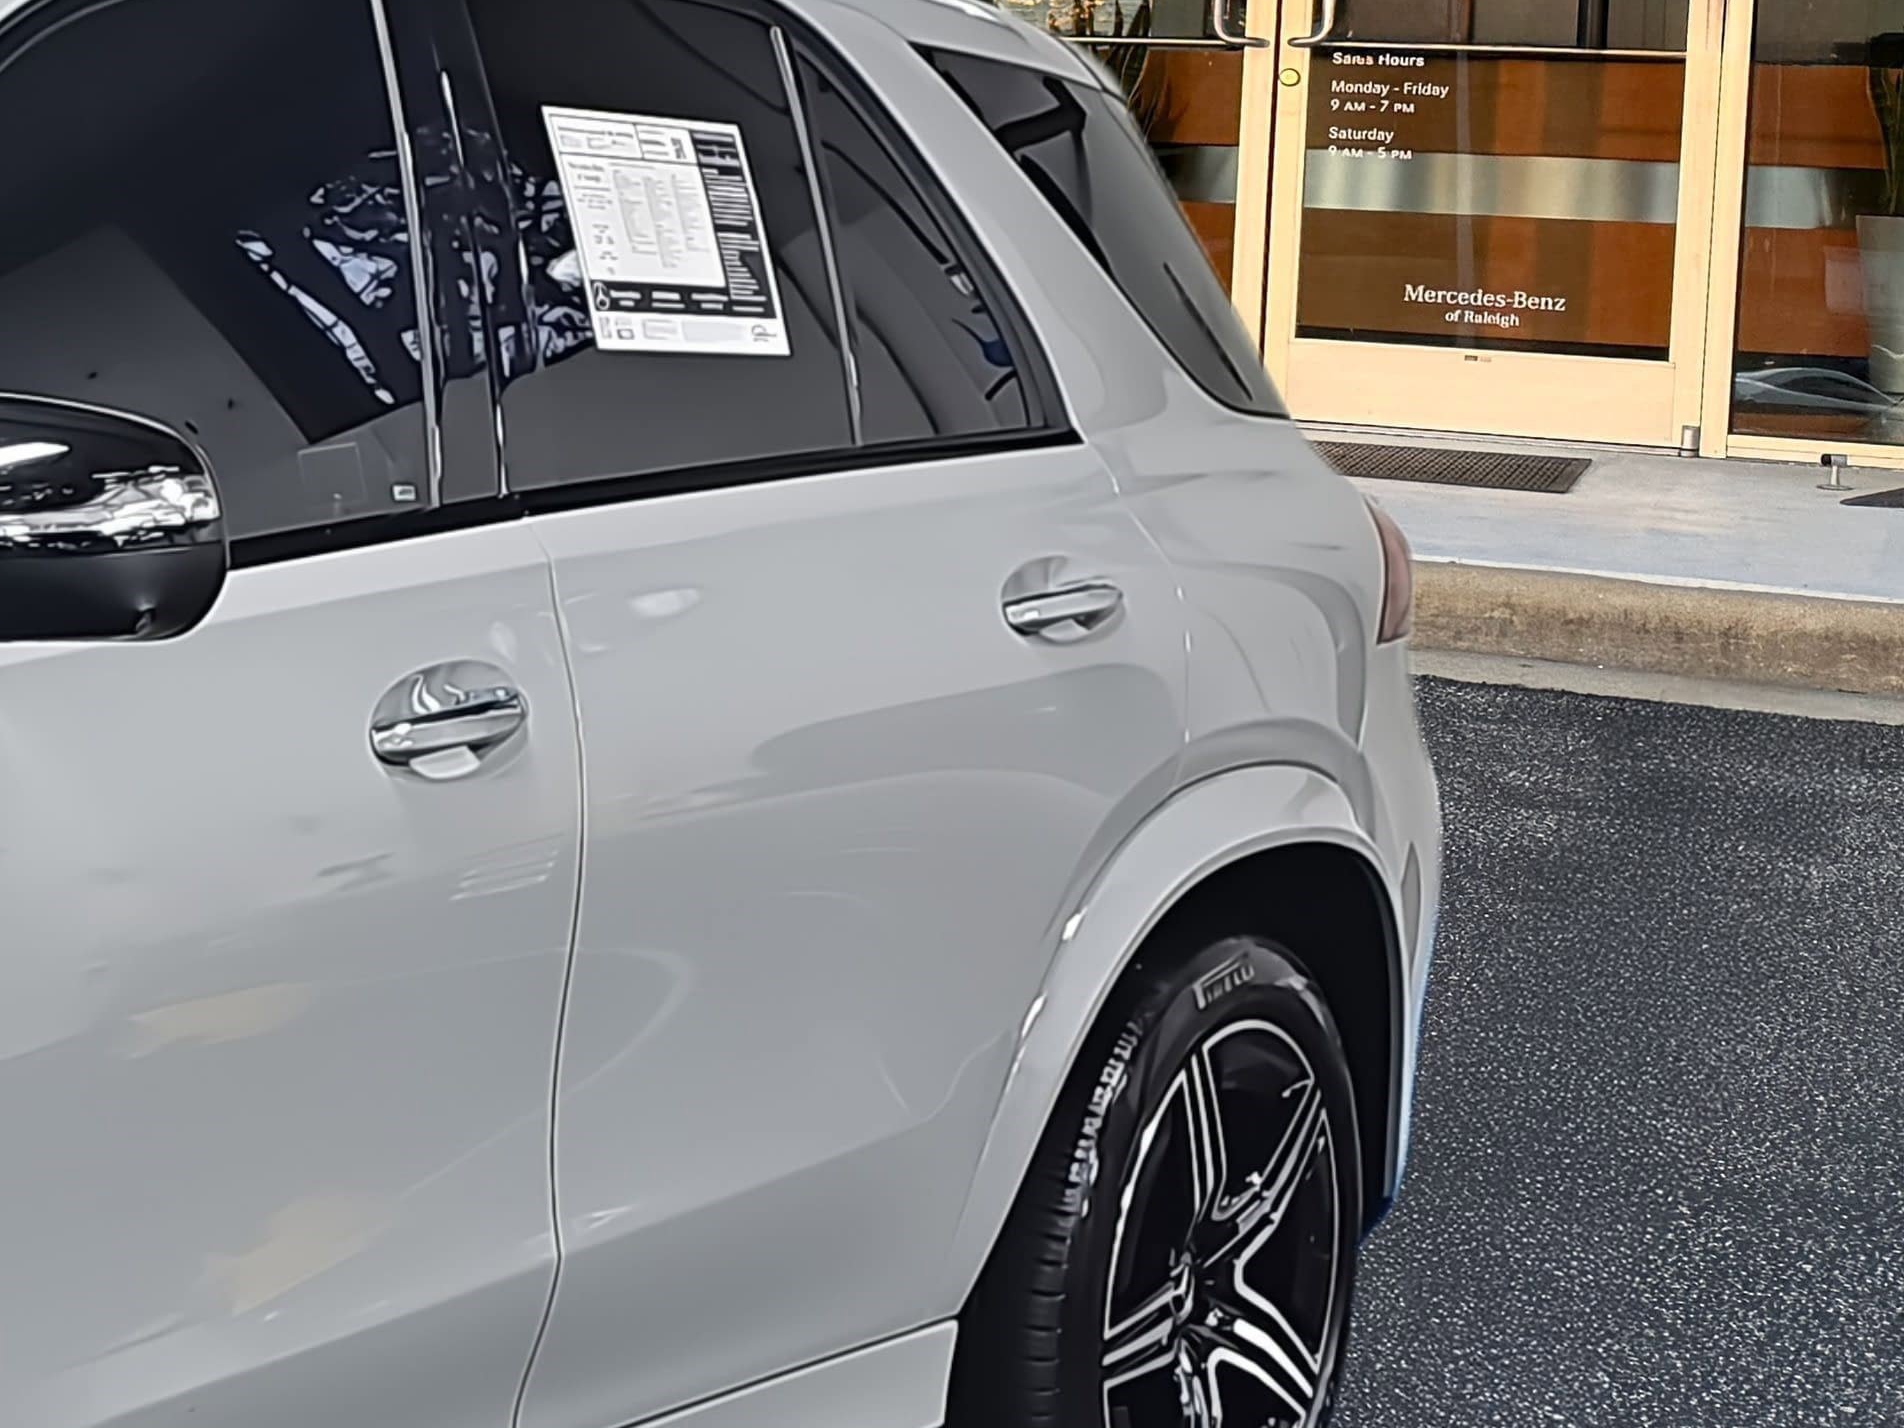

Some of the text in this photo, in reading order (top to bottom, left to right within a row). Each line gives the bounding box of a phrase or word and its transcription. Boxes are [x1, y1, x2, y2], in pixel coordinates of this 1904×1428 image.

[1378, 53, 1425, 67] Hours
[1331, 80, 1390, 97] Monday
[1403, 82, 1449, 99] Friday
[1330, 99, 1340, 111] 9
[1343, 101, 1366, 112] AM
[1379, 100, 1389, 112] 7
[1393, 103, 1415, 113] PM
[1328, 126, 1394, 144] Saturday
[1341, 148, 1364, 158] AM
[1377, 146, 1387, 159] 5
[1391, 150, 1412, 160] PM
[1403, 283, 1566, 312] Mercedes-Benz
[1445, 309, 1462, 323] of
